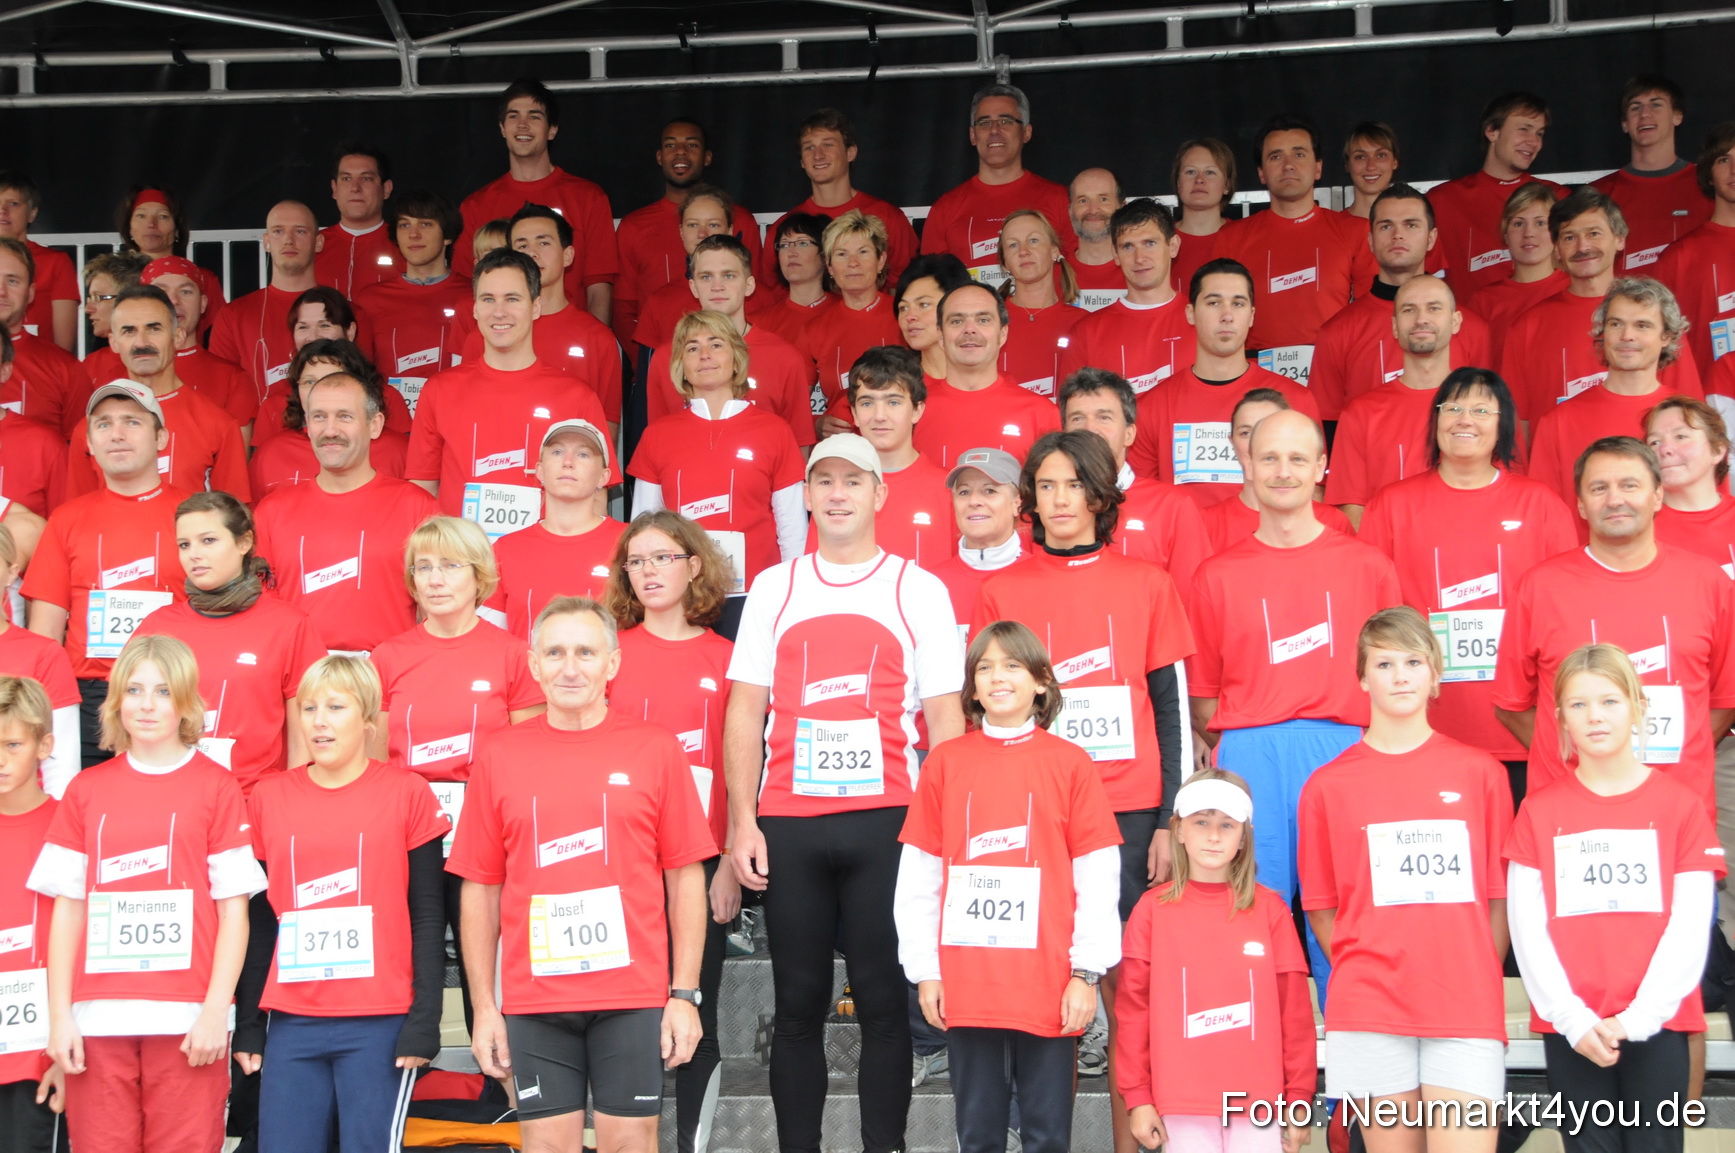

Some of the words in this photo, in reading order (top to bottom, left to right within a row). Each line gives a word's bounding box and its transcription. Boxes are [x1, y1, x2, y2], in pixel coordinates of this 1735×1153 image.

[984, 242, 999, 251] DEH
[1481, 254, 1502, 264] DEHN
[1283, 275, 1303, 286] DEHN
[1084, 295, 1112, 305] Walter
[408, 354, 427, 365] DEHN
[1277, 351, 1299, 362] Adolf
[1138, 375, 1158, 388] DEHN
[1195, 428, 1232, 439] Christia
[488, 457, 511, 467] DEHN
[485, 489, 516, 504] Philipp
[694, 502, 715, 514] DEHN
[484, 507, 530, 525] 2007
[117, 566, 140, 580] DEHN
[320, 568, 343, 583] DEHN
[1457, 584, 1482, 598] DEHN
[110, 597, 144, 609] Rainer
[1453, 617, 1483, 631] Doris
[1288, 635, 1312, 653] DEHN
[1069, 657, 1094, 673] DEHN
[820, 682, 849, 694] DEHN
[1062, 696, 1090, 710] Timo
[1066, 716, 1121, 739] 5031
[816, 728, 849, 742] Oliver
[427, 743, 453, 756] DEHN
[818, 749, 871, 770] 2332
[981, 835, 1008, 848] DEHN
[1396, 829, 1443, 845] Kathrin
[557, 839, 585, 854] DEHN
[1580, 839, 1609, 855] Alina
[120, 857, 149, 871] DEHN
[1400, 853, 1461, 876] 4034
[969, 873, 1001, 889] Tizian
[1583, 863, 1648, 886] 4033
[314, 880, 340, 896] DEHN
[117, 900, 177, 914] Marianne
[551, 900, 585, 917] Josef
[966, 898, 1025, 921] 4021
[119, 922, 181, 945] 5053
[304, 929, 359, 952] 3718
[563, 921, 608, 947] 100
[1205, 1013, 1233, 1027] DEHN
